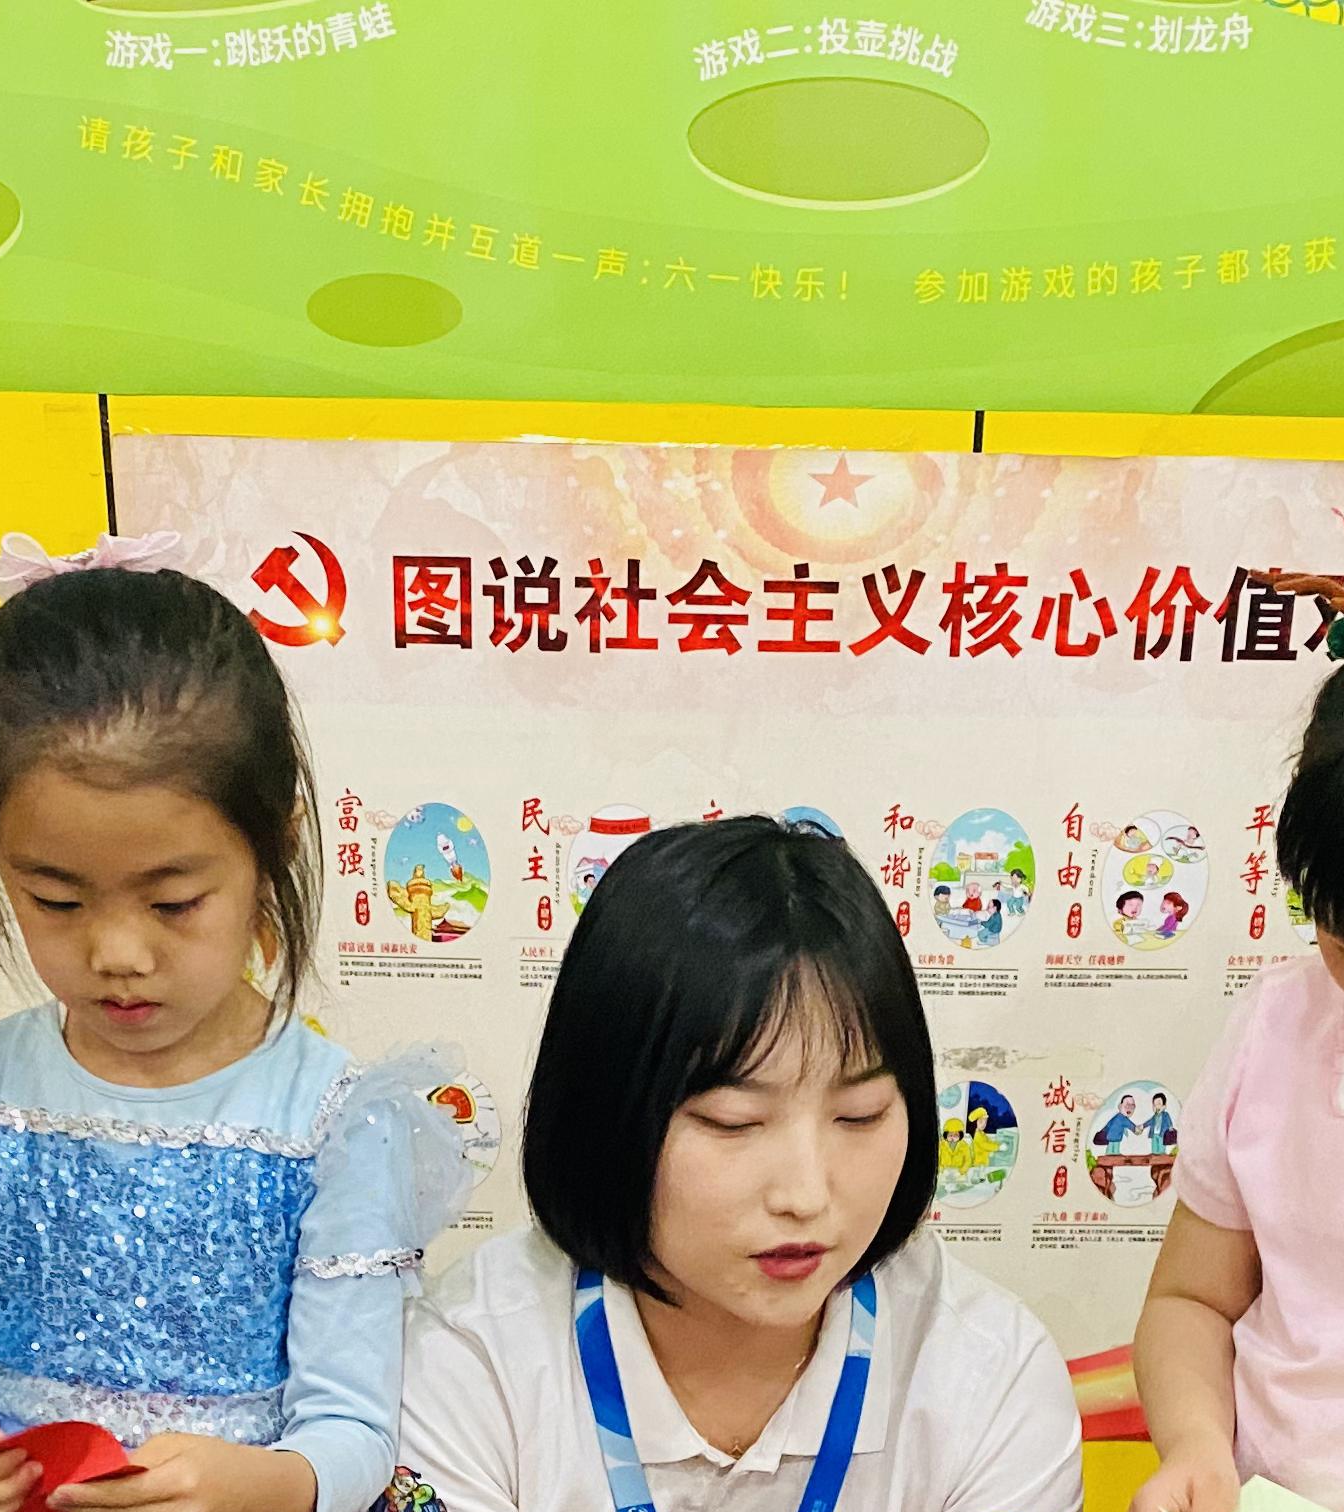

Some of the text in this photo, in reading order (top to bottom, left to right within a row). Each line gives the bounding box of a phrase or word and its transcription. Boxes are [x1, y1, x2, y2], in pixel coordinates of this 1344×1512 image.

[104, 0, 397, 71] 游戏一：跳跃的青蛙
[693, 16, 960, 82] 游戏二：投壶挑战
[1024, 0, 1254, 55] 游戏三：划龙舟
[76, 114, 851, 303] 请孩子和家长拥抱并互道一声：六一快乐！
[335, 787, 365, 883] 富强
[521, 797, 551, 883] 民主
[880, 803, 915, 889] 和谐
[1057, 802, 1085, 890] 自由
[1240, 804, 1276, 896] 平等
